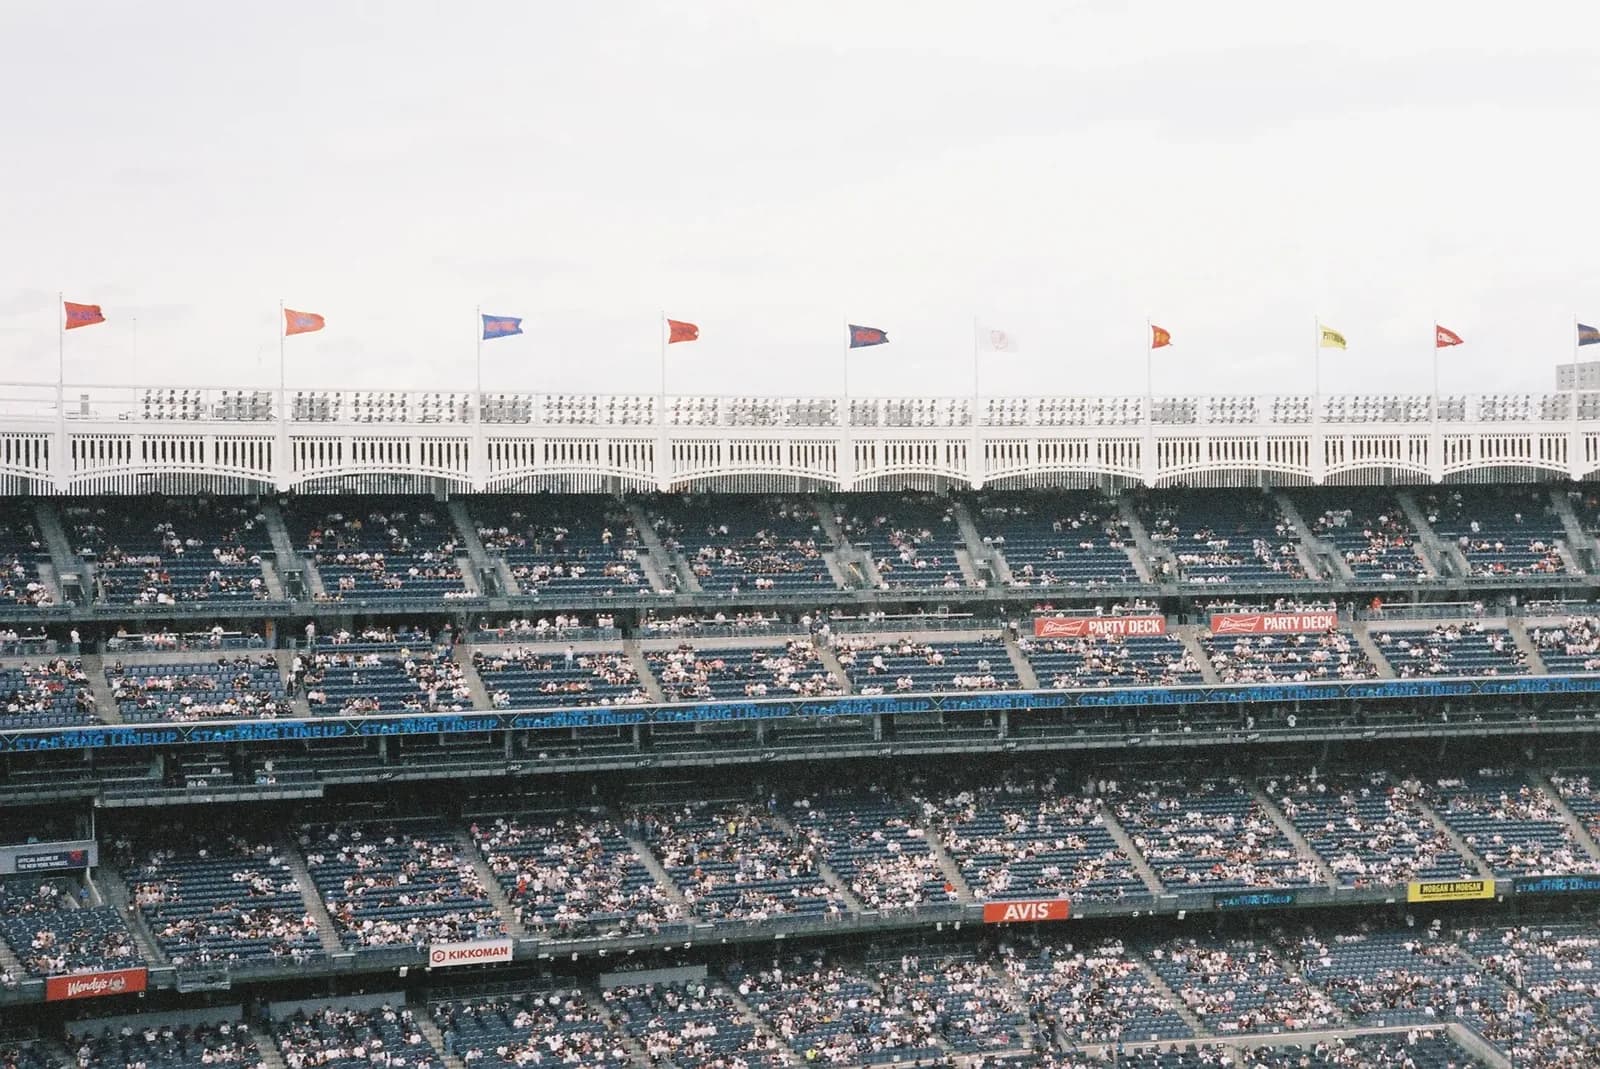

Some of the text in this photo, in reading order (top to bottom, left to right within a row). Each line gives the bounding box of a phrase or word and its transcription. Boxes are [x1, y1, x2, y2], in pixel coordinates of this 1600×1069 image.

[1088, 620, 1125, 634] PARTY
[1128, 619, 1161, 634] DECK
[1263, 616, 1300, 631] PARTY
[1302, 615, 1333, 630] DECK
[1423, 884, 1449, 893] MORGAN
[1455, 882, 1481, 891] MORGAN
[1003, 902, 1049, 920] AVIS
[448, 946, 508, 960] KIKKOMAN
[67, 977, 107, 997] Wendy's
